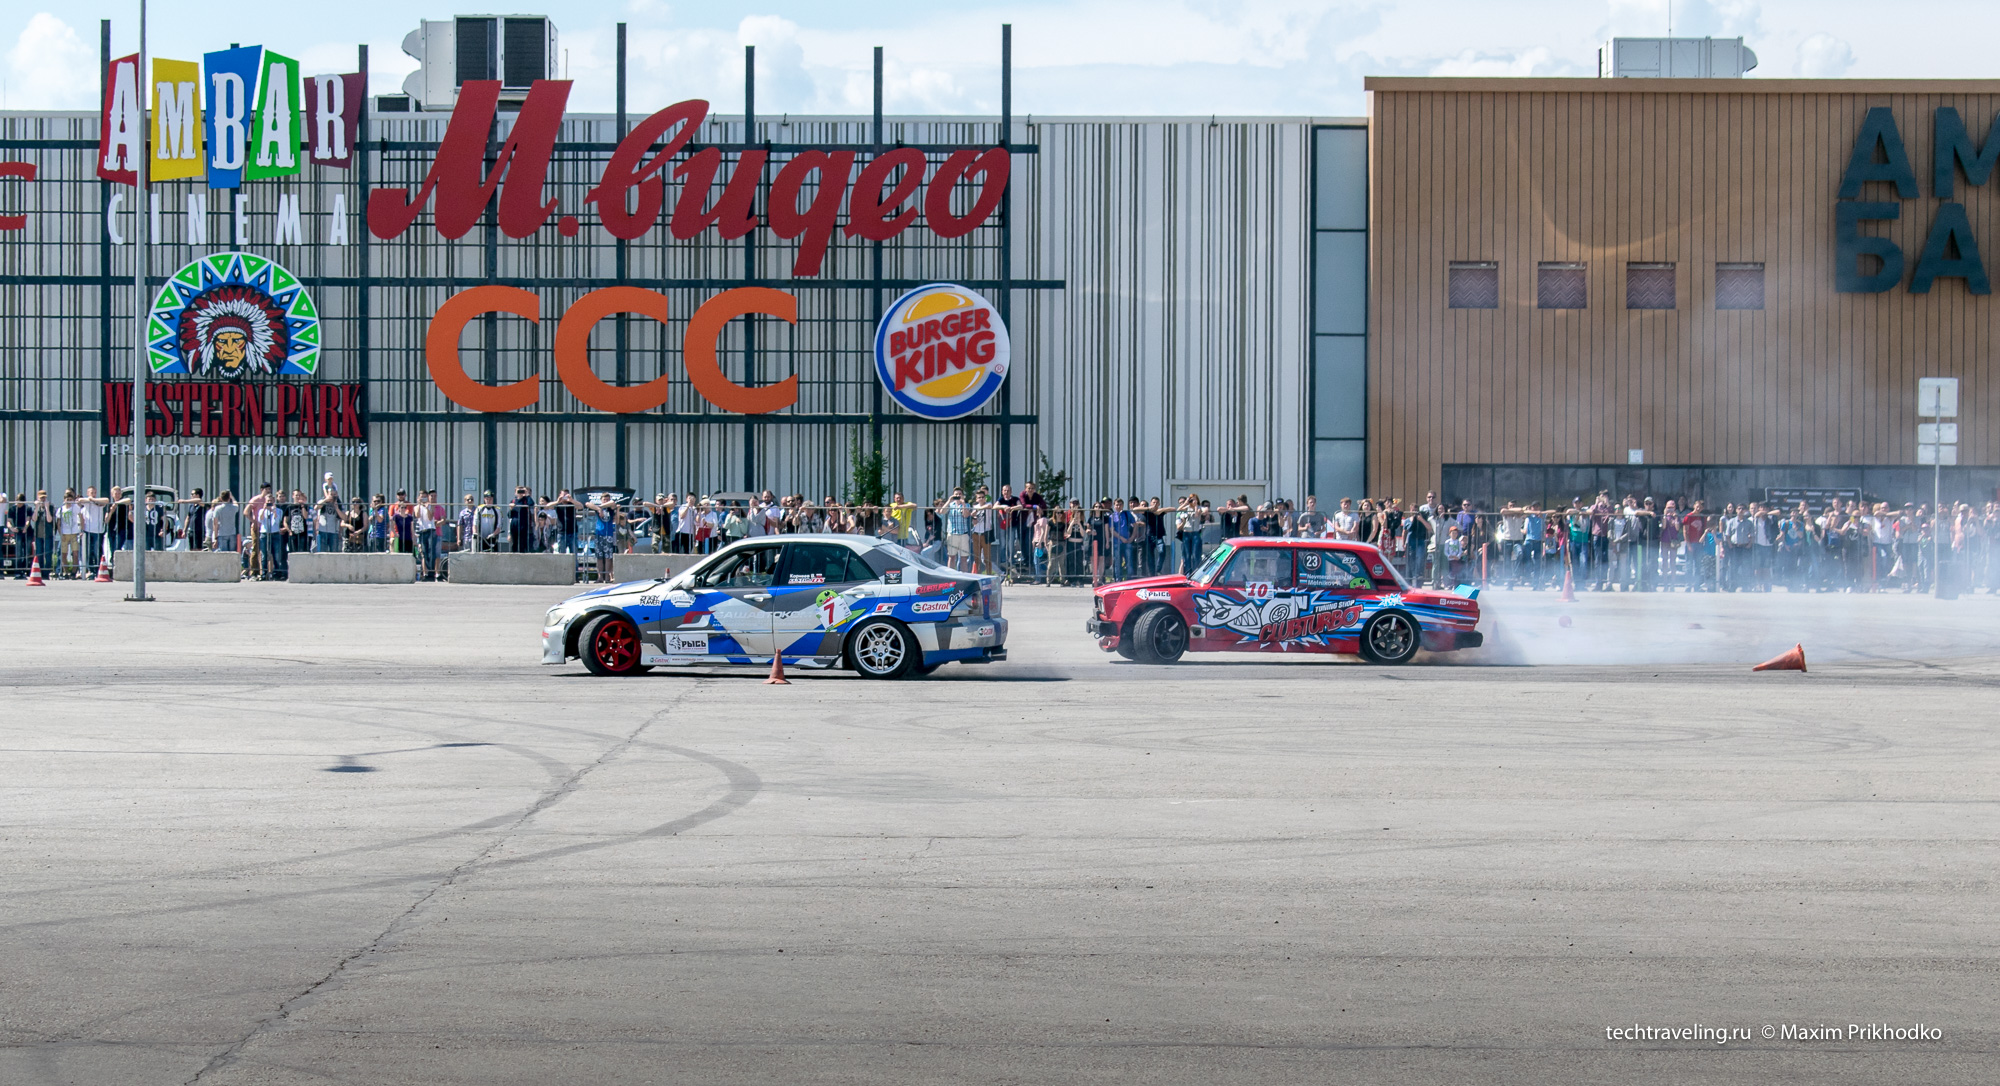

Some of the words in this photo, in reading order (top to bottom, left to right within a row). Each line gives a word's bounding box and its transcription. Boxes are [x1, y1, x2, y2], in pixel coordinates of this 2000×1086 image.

[103, 60, 348, 171] AMBAR
[107, 193, 349, 246] CINEMA
[1835, 202, 1991, 295] БА
[889, 307, 992, 358] BURGER
[893, 330, 998, 393] KING
[104, 382, 267, 438] WESTERN
[276, 382, 364, 439] PARK
[100, 443, 218, 457] ТЕРИТОРИЯ
[228, 441, 369, 458] ПРИКЛЮЧЕНИЙ
[1306, 555, 1318, 567] 23
[1248, 582, 1268, 598] 10
[823, 602, 835, 626] 7
[922, 602, 950, 612] Castrol
[1314, 602, 1338, 614] TUNING
[1338, 599, 1356, 610] SHOP
[1258, 604, 1364, 643] CLUBTURBO
[682, 640, 706, 648] РЫСЬ
